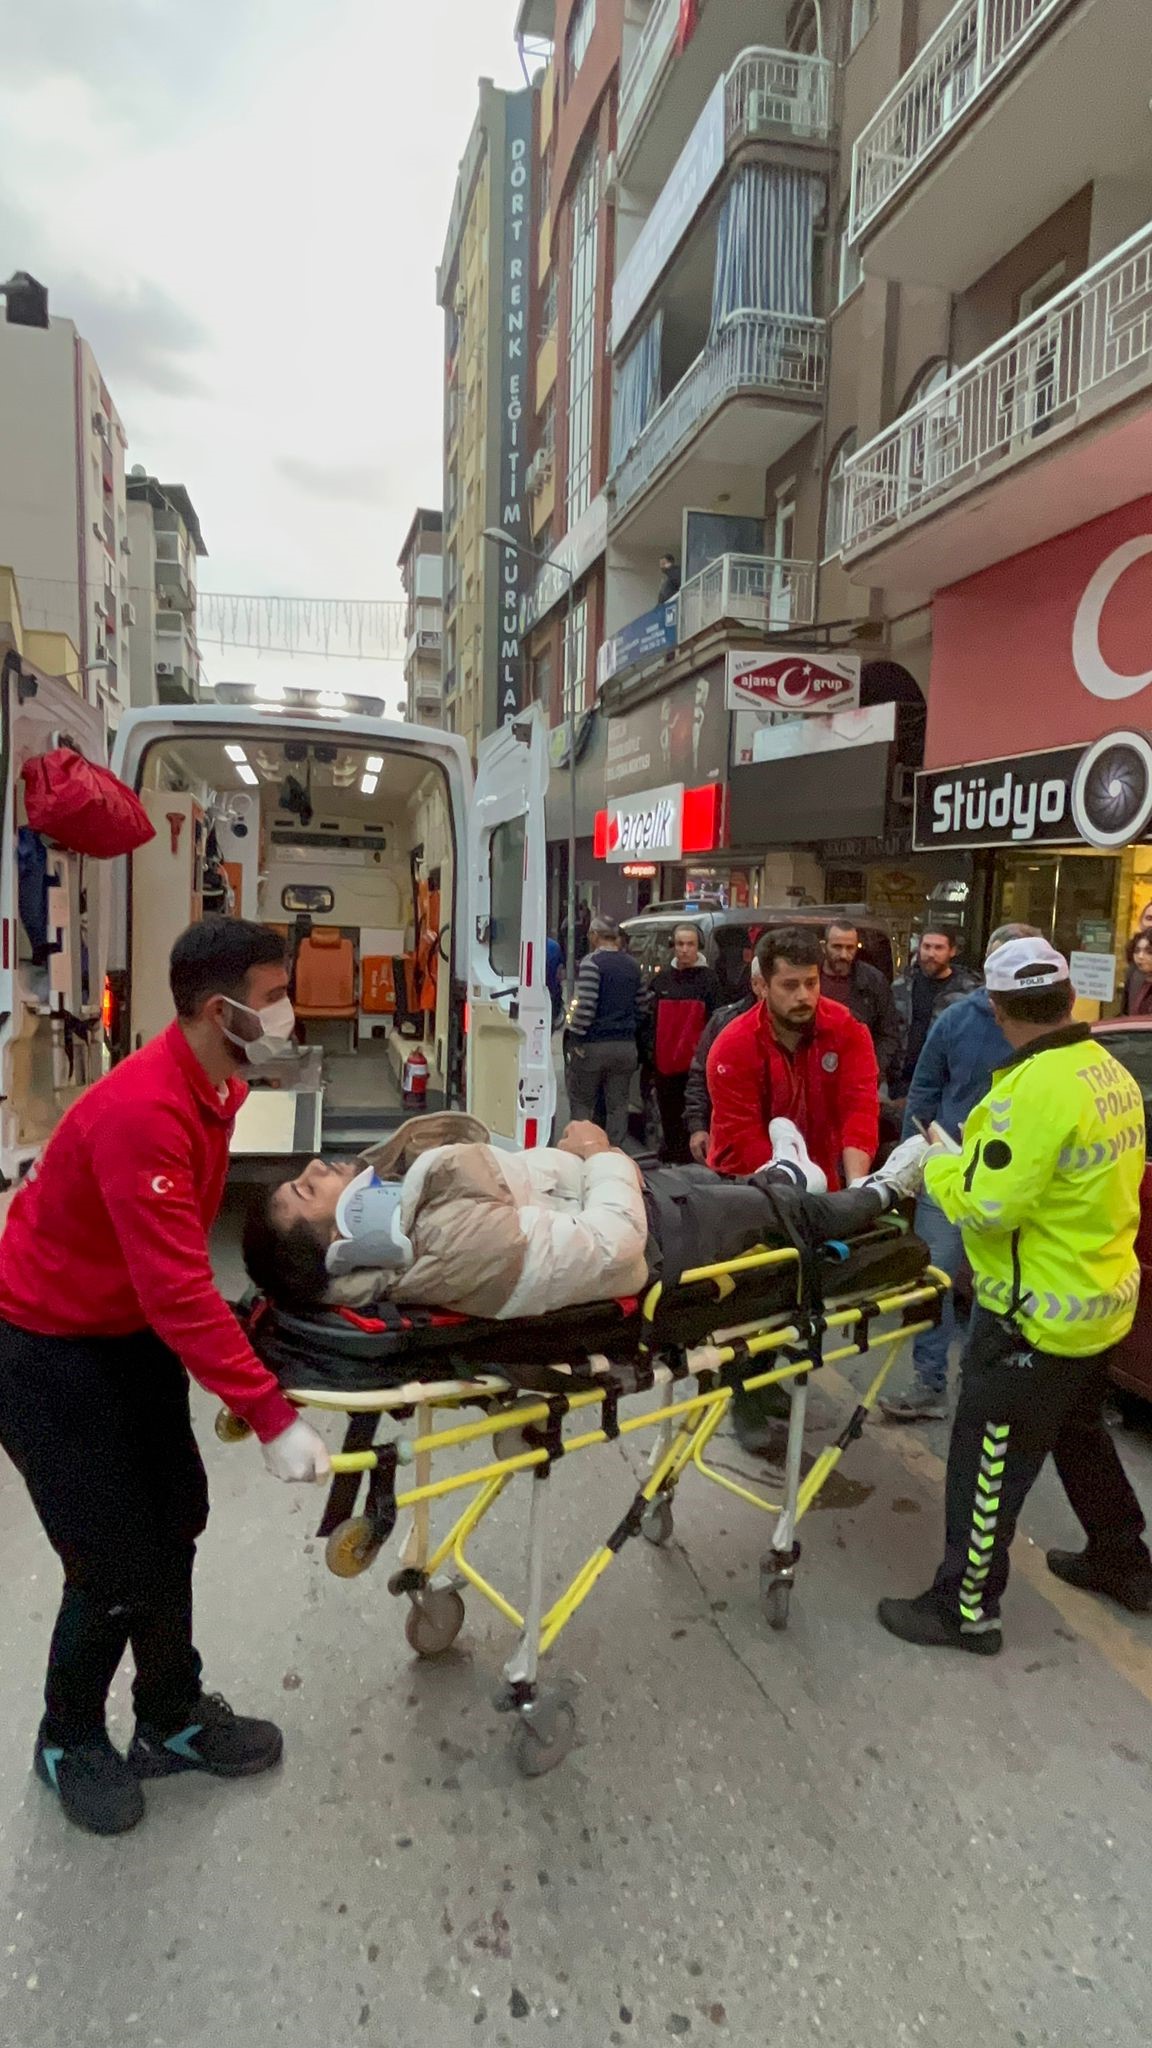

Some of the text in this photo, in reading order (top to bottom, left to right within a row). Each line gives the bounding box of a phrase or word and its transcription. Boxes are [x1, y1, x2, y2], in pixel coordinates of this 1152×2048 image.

[510, 139, 526, 241] DÖRT
[508, 259, 523, 358] RENK
[504, 374, 521, 525] EĞİTİM
[741, 674, 843, 692] ajans grup
[932, 772, 1066, 840] Stüdyo
[1095, 1082, 1141, 1125] POLİS
